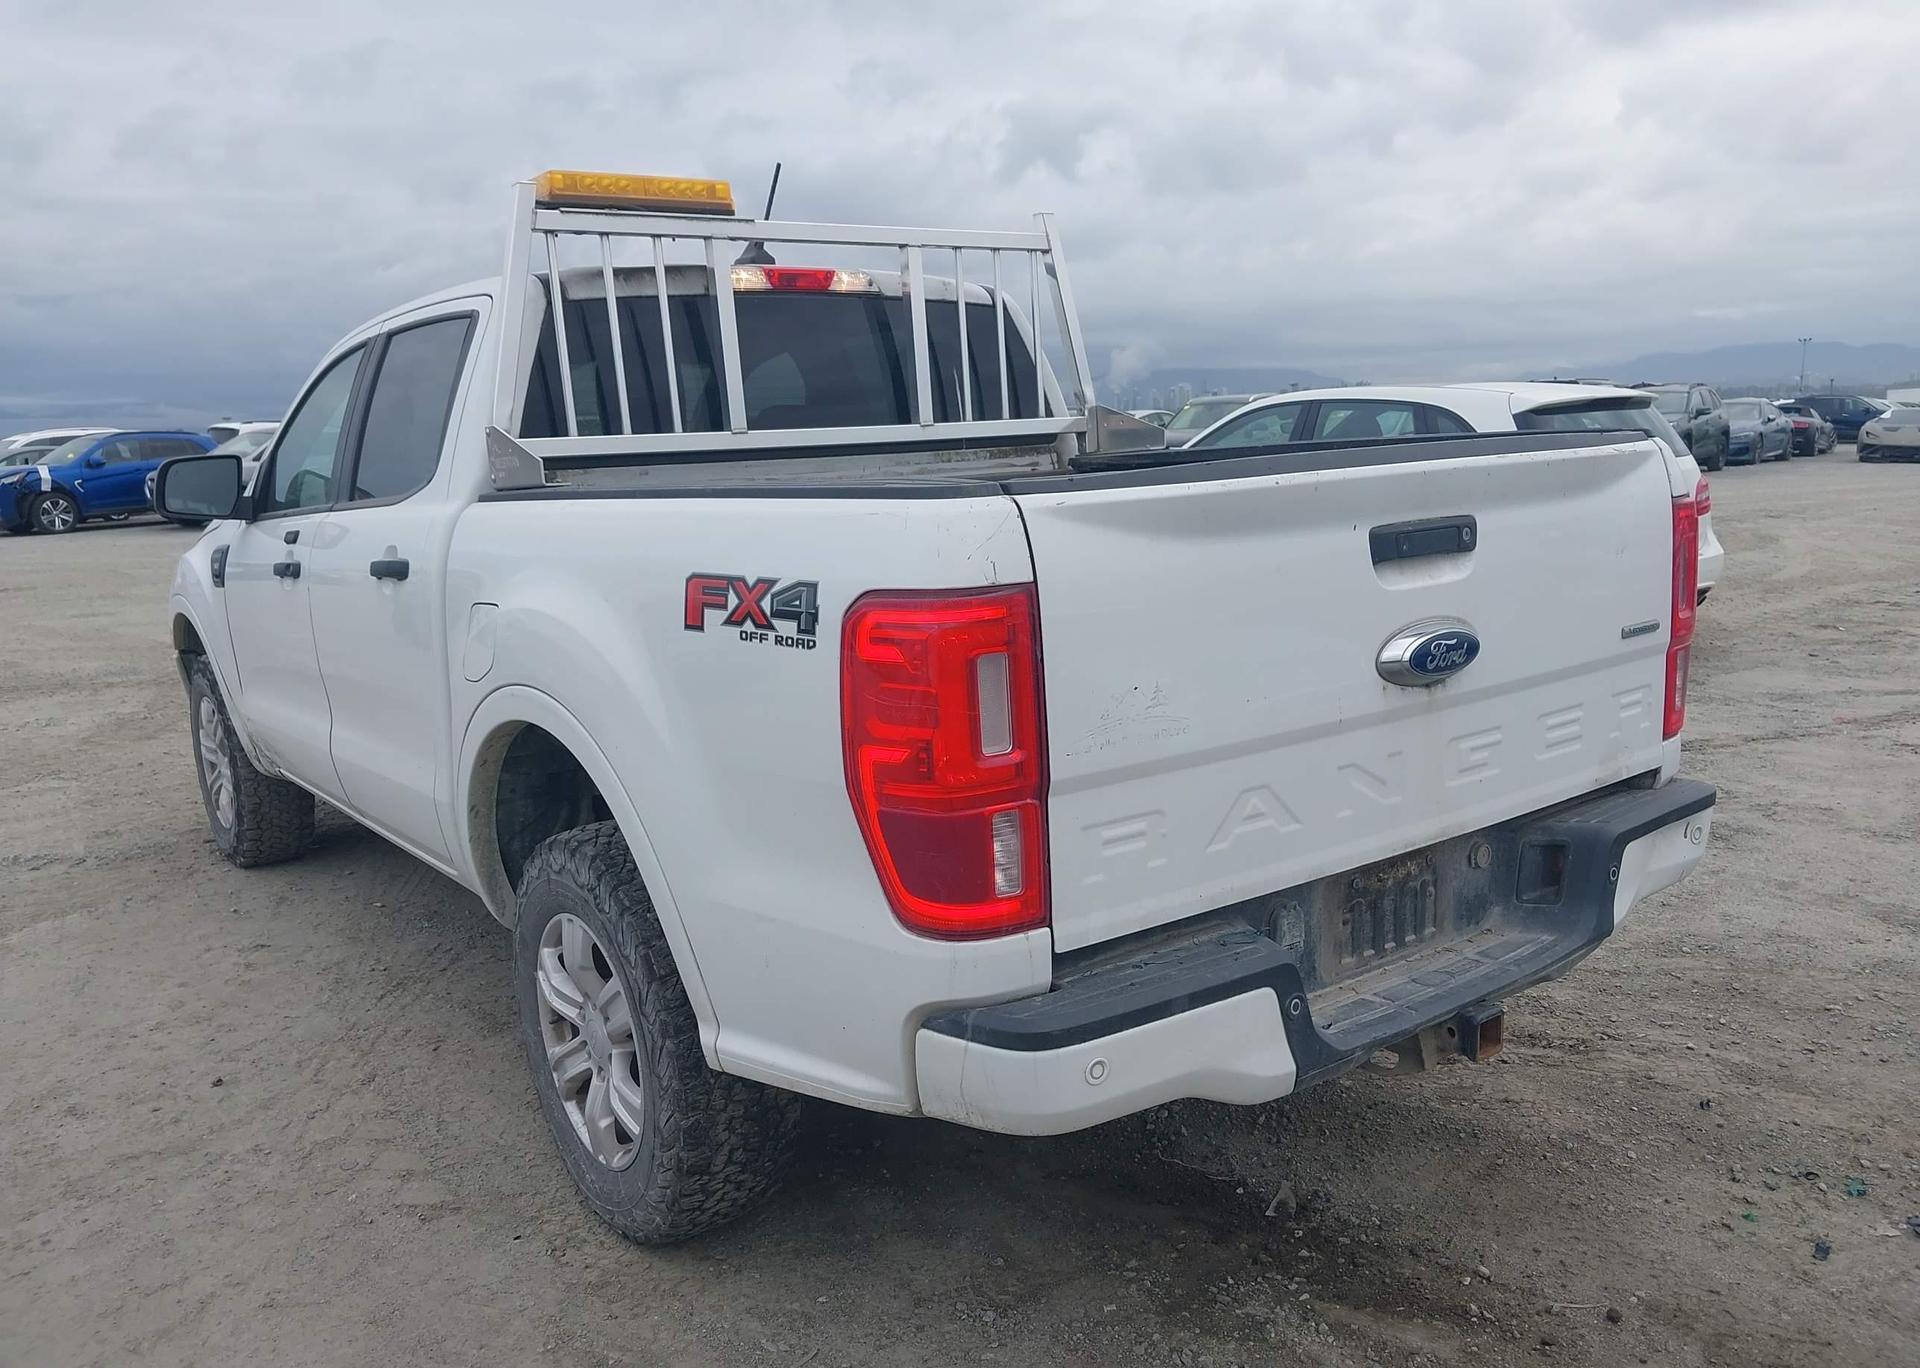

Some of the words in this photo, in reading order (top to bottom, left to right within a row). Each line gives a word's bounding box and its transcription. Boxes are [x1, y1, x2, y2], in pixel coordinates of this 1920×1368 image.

[684, 572, 819, 637] FX4
[739, 630, 769, 644] OFF
[774, 635, 817, 650] ROAD
[1426, 638, 1468, 670] Ford
[1079, 684, 1653, 886] RANGER
